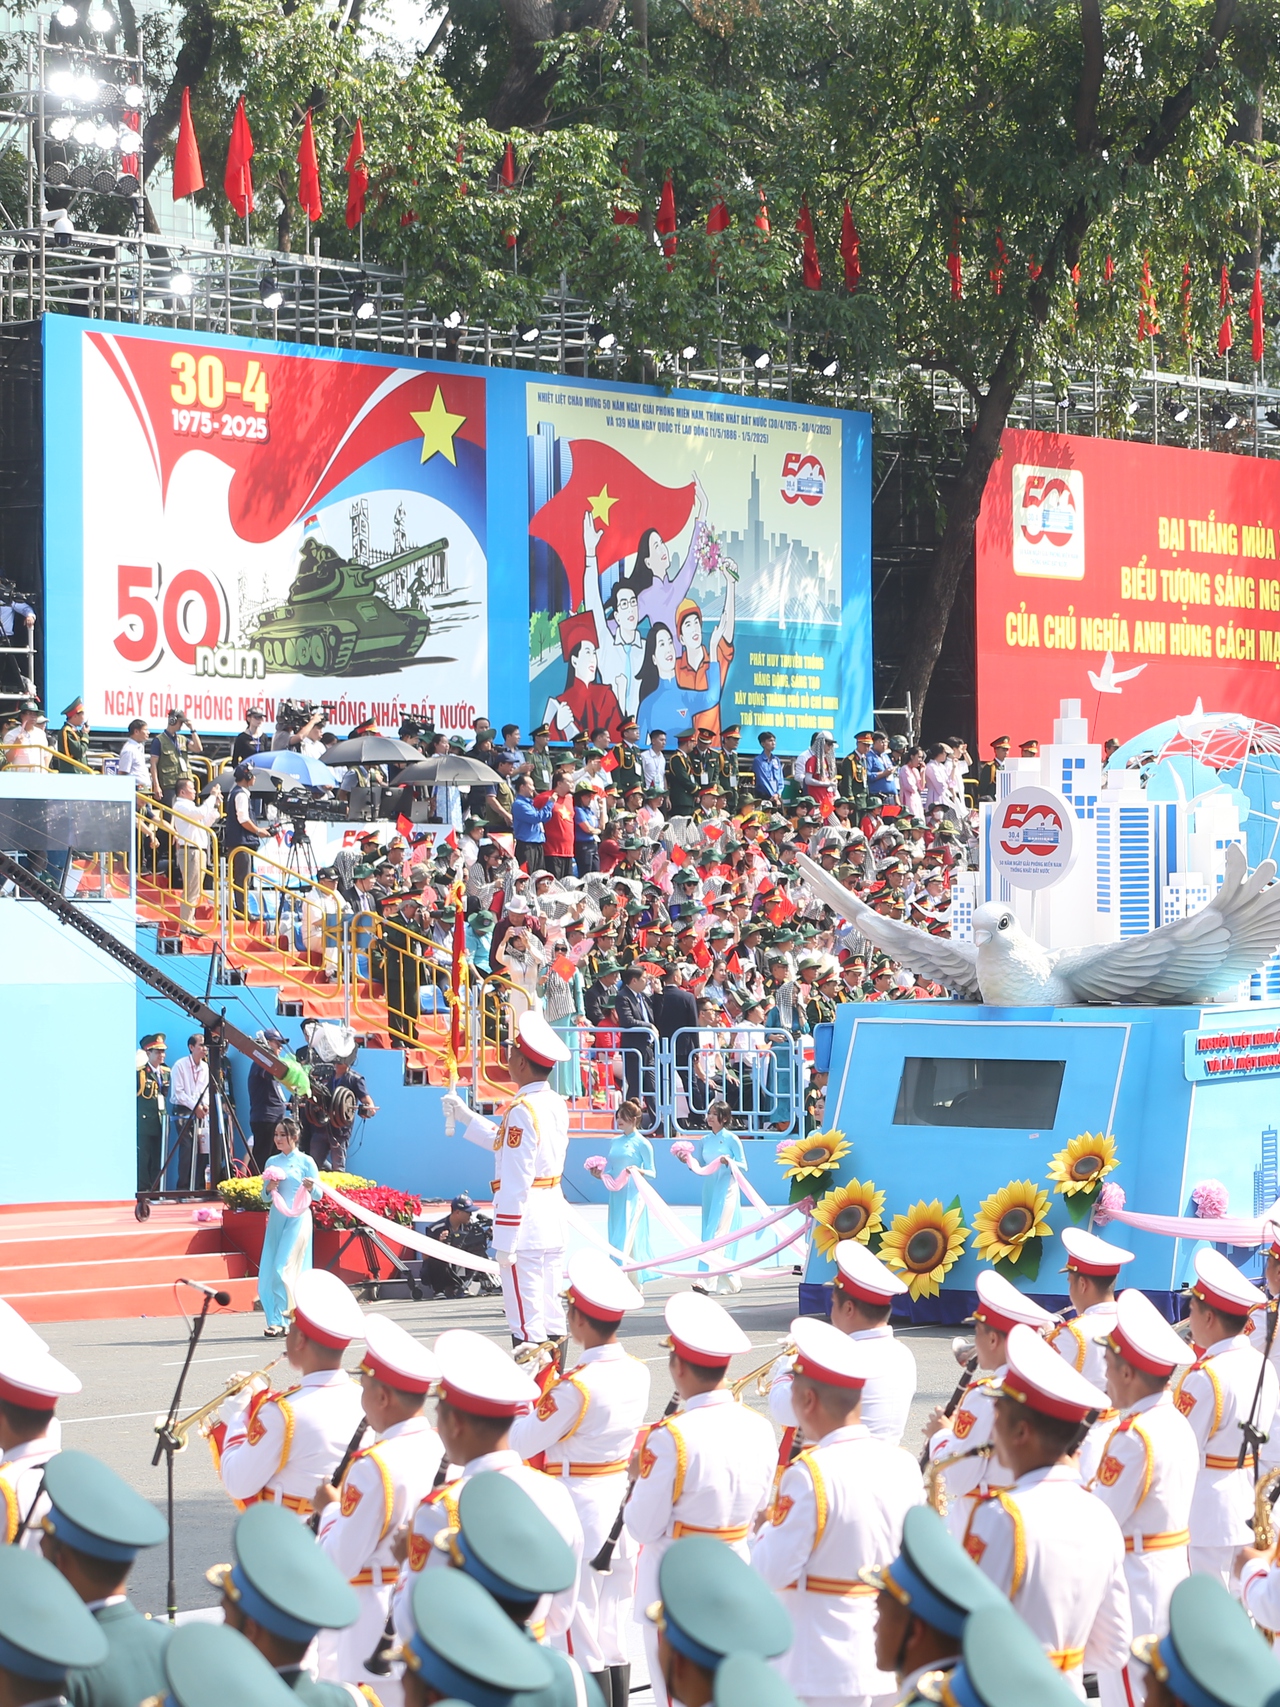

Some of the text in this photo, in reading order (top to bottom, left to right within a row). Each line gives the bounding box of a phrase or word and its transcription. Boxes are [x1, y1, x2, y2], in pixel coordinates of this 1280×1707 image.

[170, 351, 270, 413] 30-4
[603, 399, 610, 410] 50
[616, 417, 626, 428] 139
[682, 424, 691, 435] LAO
[1158, 516, 1185, 557] ĐẠI
[1188, 509, 1238, 556] THẮNG
[1242, 520, 1276, 560] MÙA
[1121, 554, 1157, 602] BIỂU
[1160, 567, 1211, 611] TƯỢNG
[1214, 568, 1256, 609] SÁNG
[113, 564, 221, 666] 50
[1005, 601, 1040, 648] CỦA
[1043, 605, 1077, 650] CHỦ
[1080, 612, 1130, 652] NGHĨA
[1133, 620, 1166, 655] ANH
[1169, 616, 1212, 658] HÙNG
[1215, 620, 1255, 660] CÁCH
[195, 641, 266, 680] năm
[104, 685, 144, 717] NGÀY
[184, 690, 233, 721] PHÓNG
[440, 700, 476, 730] NƯỚC
[1198, 1032, 1230, 1051] NGƯỜI
[1231, 1031, 1252, 1048] VIỆT
[1253, 1032, 1275, 1046] NAM
[1207, 1056, 1220, 1072] VÀ
[1222, 1055, 1235, 1071] LÀ
[1236, 1053, 1258, 1070] MỘT
